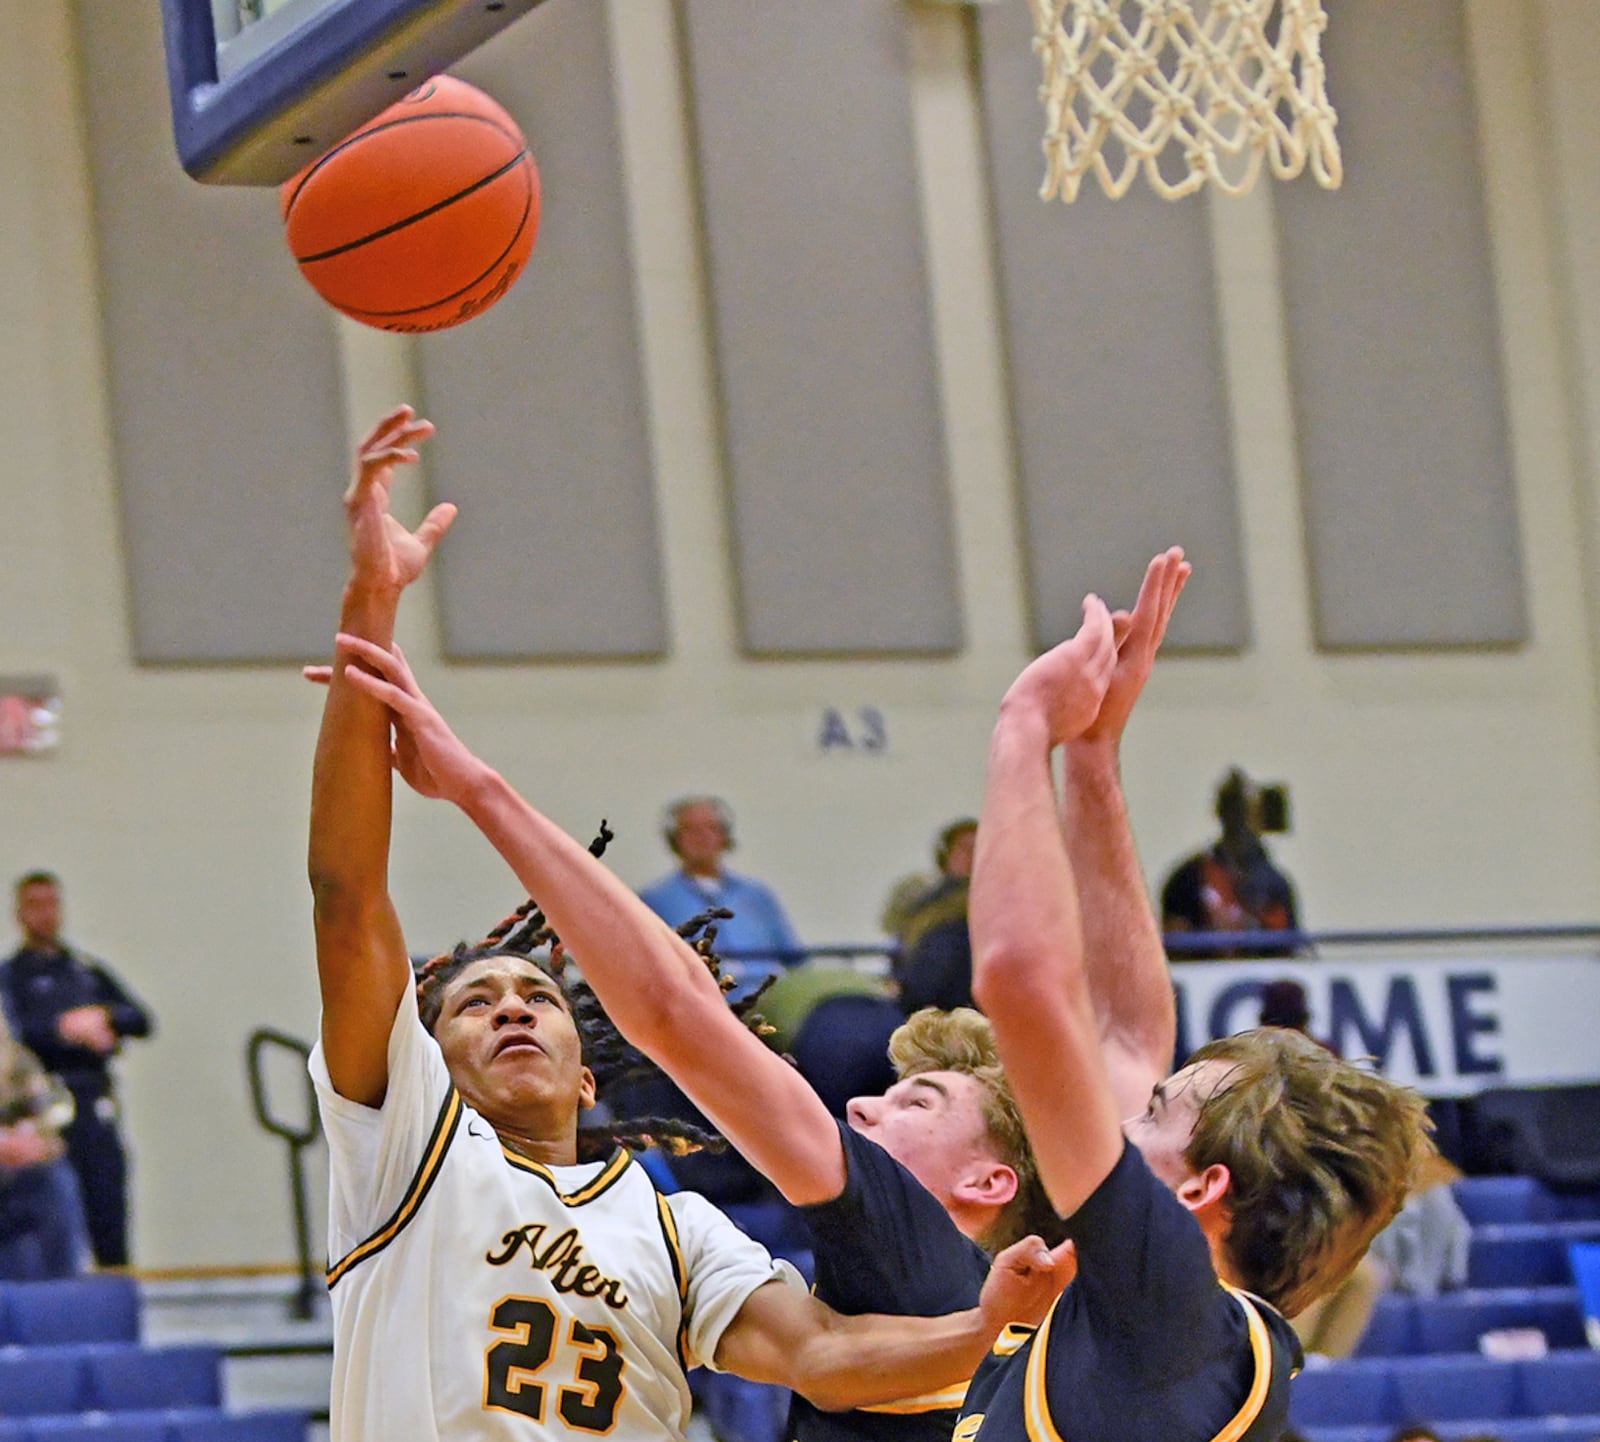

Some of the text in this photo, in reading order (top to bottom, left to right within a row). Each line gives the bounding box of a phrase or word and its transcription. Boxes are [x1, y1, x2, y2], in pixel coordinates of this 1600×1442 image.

[818, 706, 887, 754] A3
[1168, 974, 1502, 1077] ME
[485, 1223, 629, 1311] Alter
[482, 1293, 628, 1437] 23
